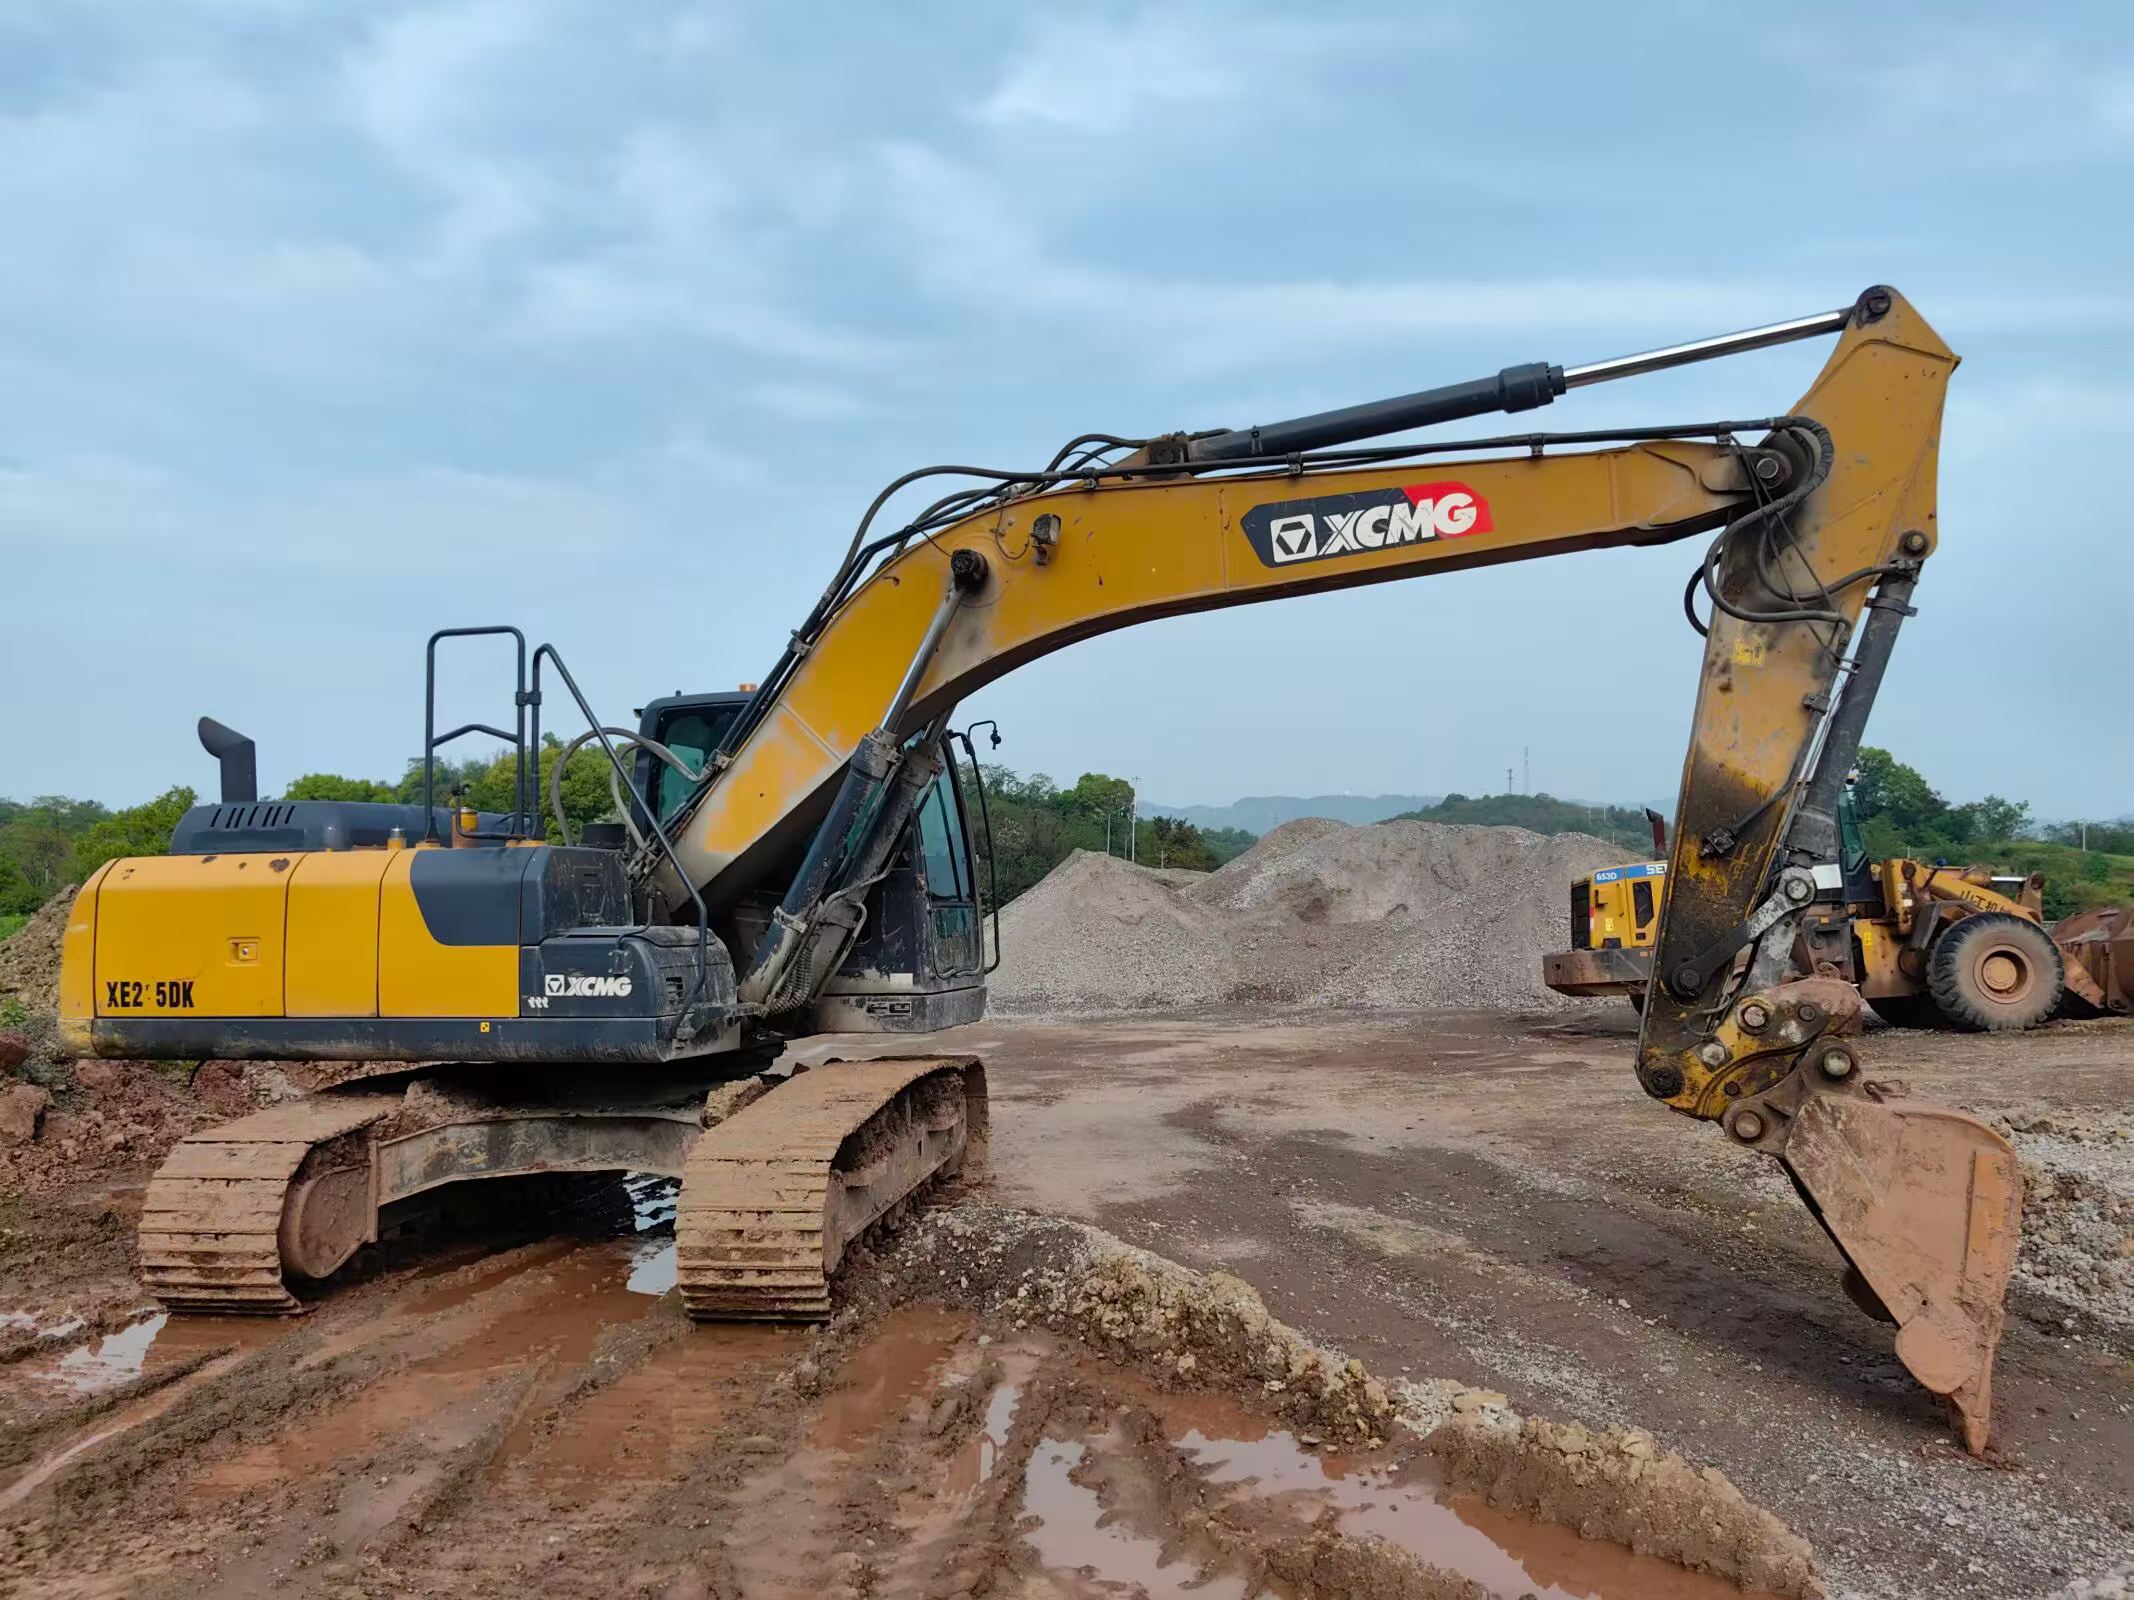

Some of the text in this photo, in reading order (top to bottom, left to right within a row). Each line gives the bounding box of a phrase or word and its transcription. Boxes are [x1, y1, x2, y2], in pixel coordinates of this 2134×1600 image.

[1318, 492, 1477, 556] XCMG
[106, 981, 195, 1008] XE25DK
[565, 976, 632, 997] XCMG
